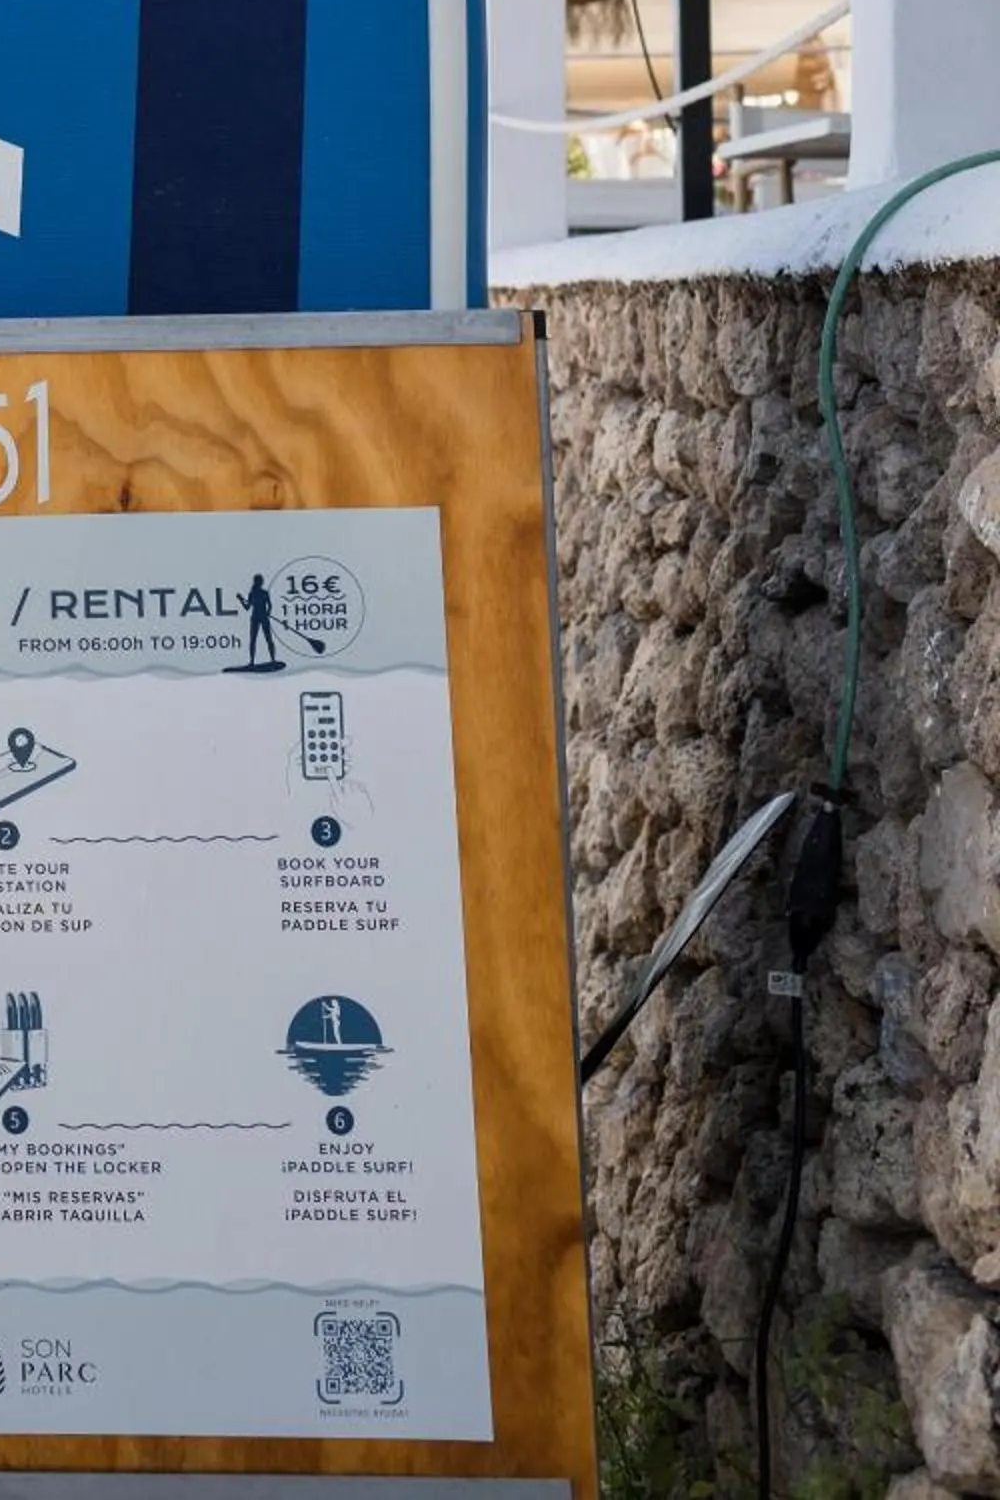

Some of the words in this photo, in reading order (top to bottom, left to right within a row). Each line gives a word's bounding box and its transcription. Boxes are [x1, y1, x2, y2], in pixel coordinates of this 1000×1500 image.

[286, 575, 341, 594] 16€
[11, 587, 30, 626] /
[50, 587, 239, 619] RENTAL
[281, 604, 287, 616] 1
[295, 603, 347, 615] HORA
[295, 618, 348, 630] HOUR
[19, 638, 71, 653] FROM
[77, 637, 143, 651] 06:00h
[152, 637, 174, 650] TO
[182, 635, 241, 649] 19:00h
[24, 863, 70, 875] YOUR
[277, 857, 326, 870] BOOK
[334, 857, 380, 869] YOUR
[279, 875, 385, 888] SURFBOARD
[51, 903, 73, 914] TU
[281, 901, 359, 913] RESERVA
[366, 901, 388, 913] TU
[31, 920, 54, 932] DE
[60, 920, 93, 932] SUP
[281, 918, 349, 931] PADDLE
[356, 918, 400, 931] SURF
[318, 1143, 375, 1155] ENJOY
[1, 1162, 47, 1174] OPEN
[53, 1161, 87, 1174] THE
[93, 1161, 162, 1174] LOCKER
[363, 1160, 414, 1173] SURF!
[293, 1190, 379, 1203] DISFRUTA
[387, 1190, 407, 1203] EL
[1, 1209, 53, 1222] ABRIR
[60, 1208, 145, 1222] TAQUILLA
[367, 1208, 418, 1221] SURF!
[21, 1339, 71, 1358] SON
[21, 1361, 98, 1383] PARC
